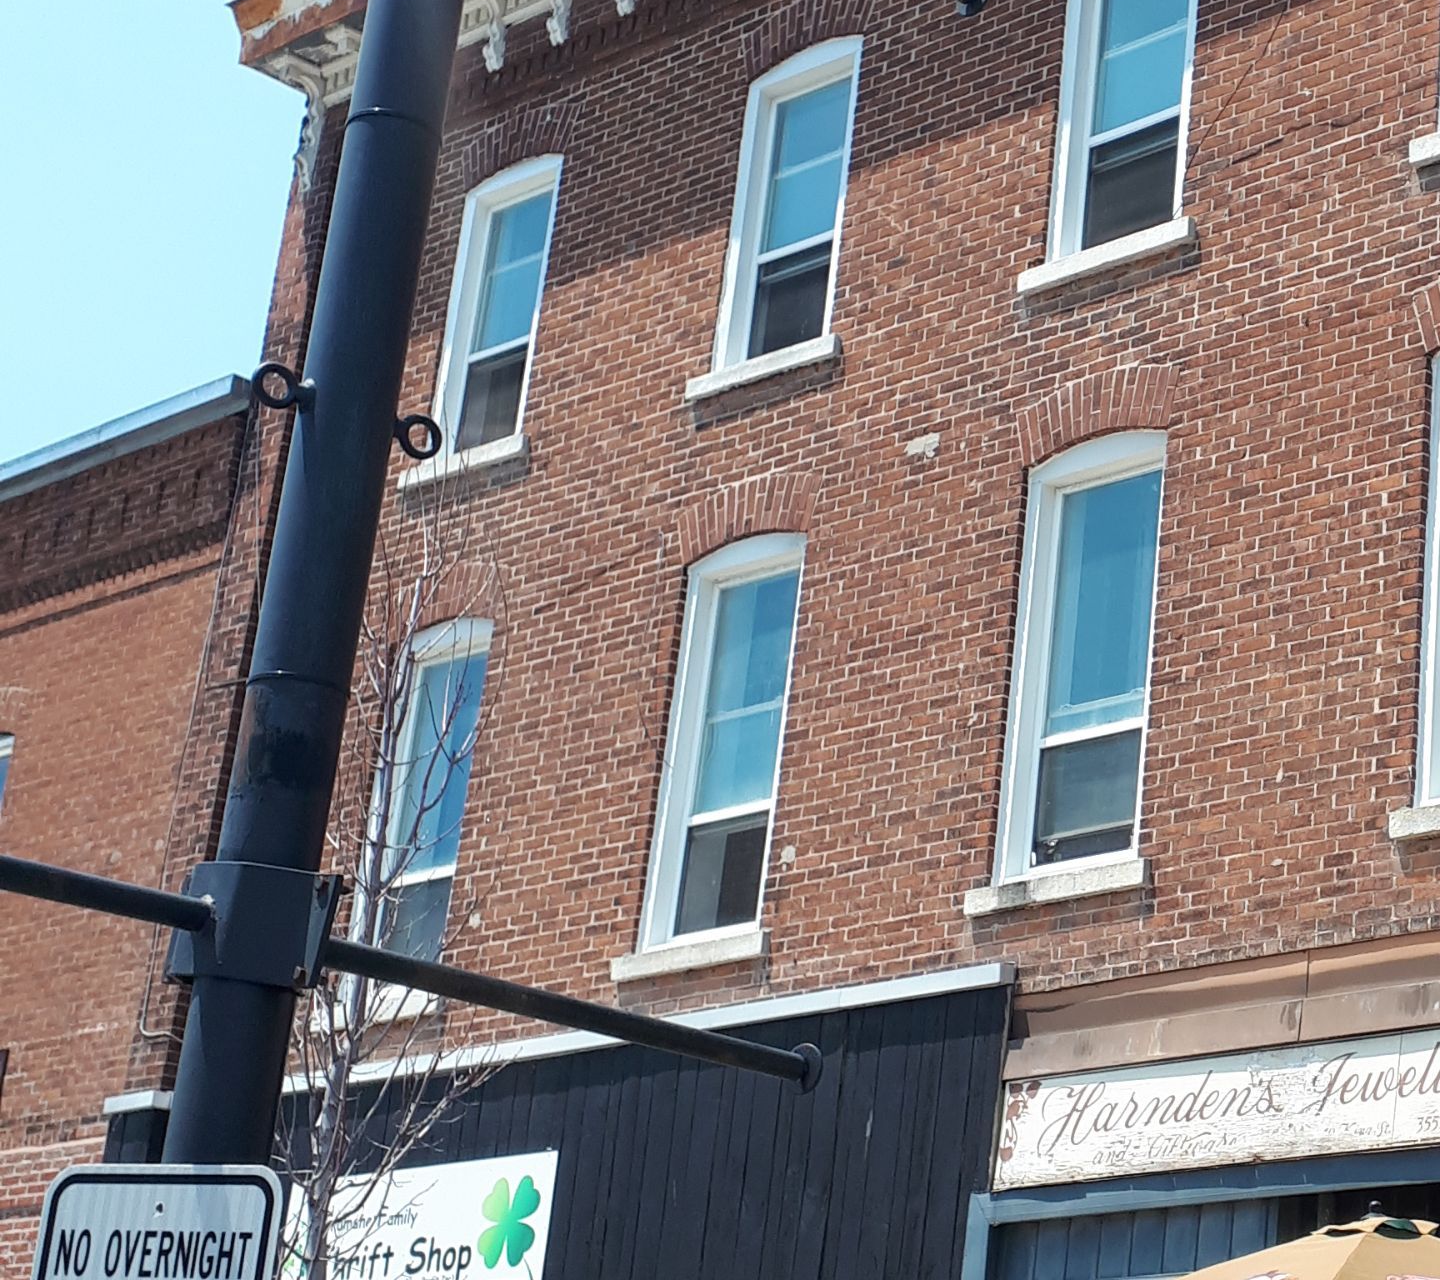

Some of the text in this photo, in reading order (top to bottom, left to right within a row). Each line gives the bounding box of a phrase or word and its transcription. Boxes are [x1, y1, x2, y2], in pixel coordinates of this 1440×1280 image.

[378, 1205, 418, 1229] Family
[54, 1229, 253, 1280] NO OVERNIGHT
